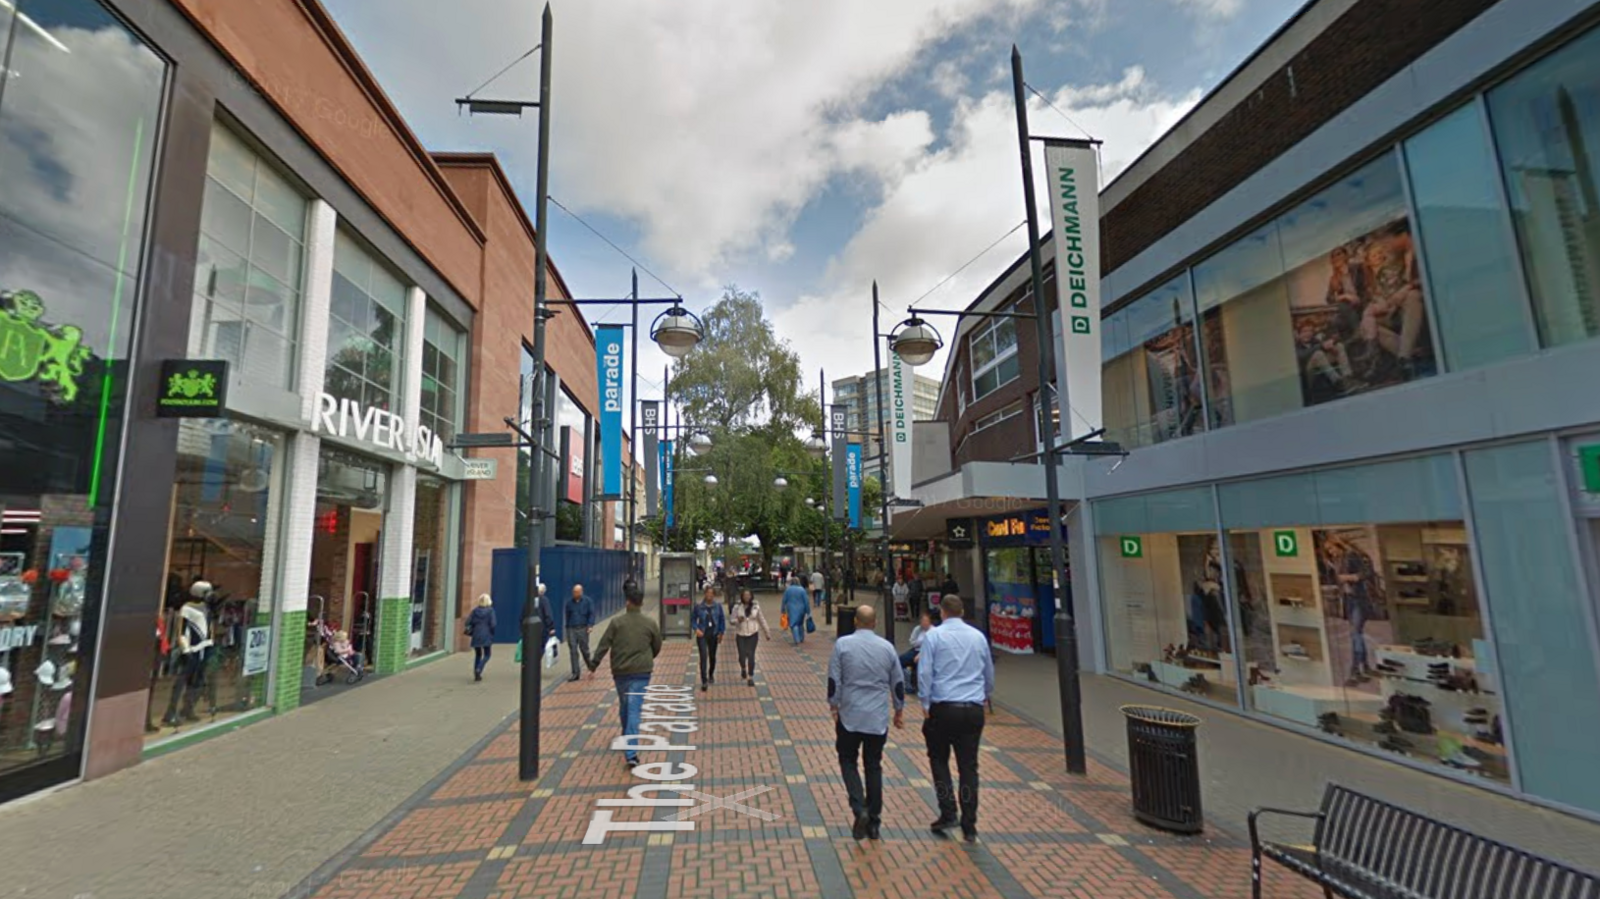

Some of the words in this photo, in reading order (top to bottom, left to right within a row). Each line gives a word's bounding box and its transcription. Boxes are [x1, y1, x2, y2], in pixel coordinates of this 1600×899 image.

[1058, 167, 1088, 309] DEICHMANN
[604, 342, 621, 412] parade
[893, 349, 905, 429] DEICHMANN
[310, 391, 405, 452] RIVER
[645, 408, 657, 436] BHS
[833, 412, 845, 439] BHS
[847, 451, 859, 489] parade
[1122, 538, 1141, 556] D
[1275, 532, 1295, 555] D
